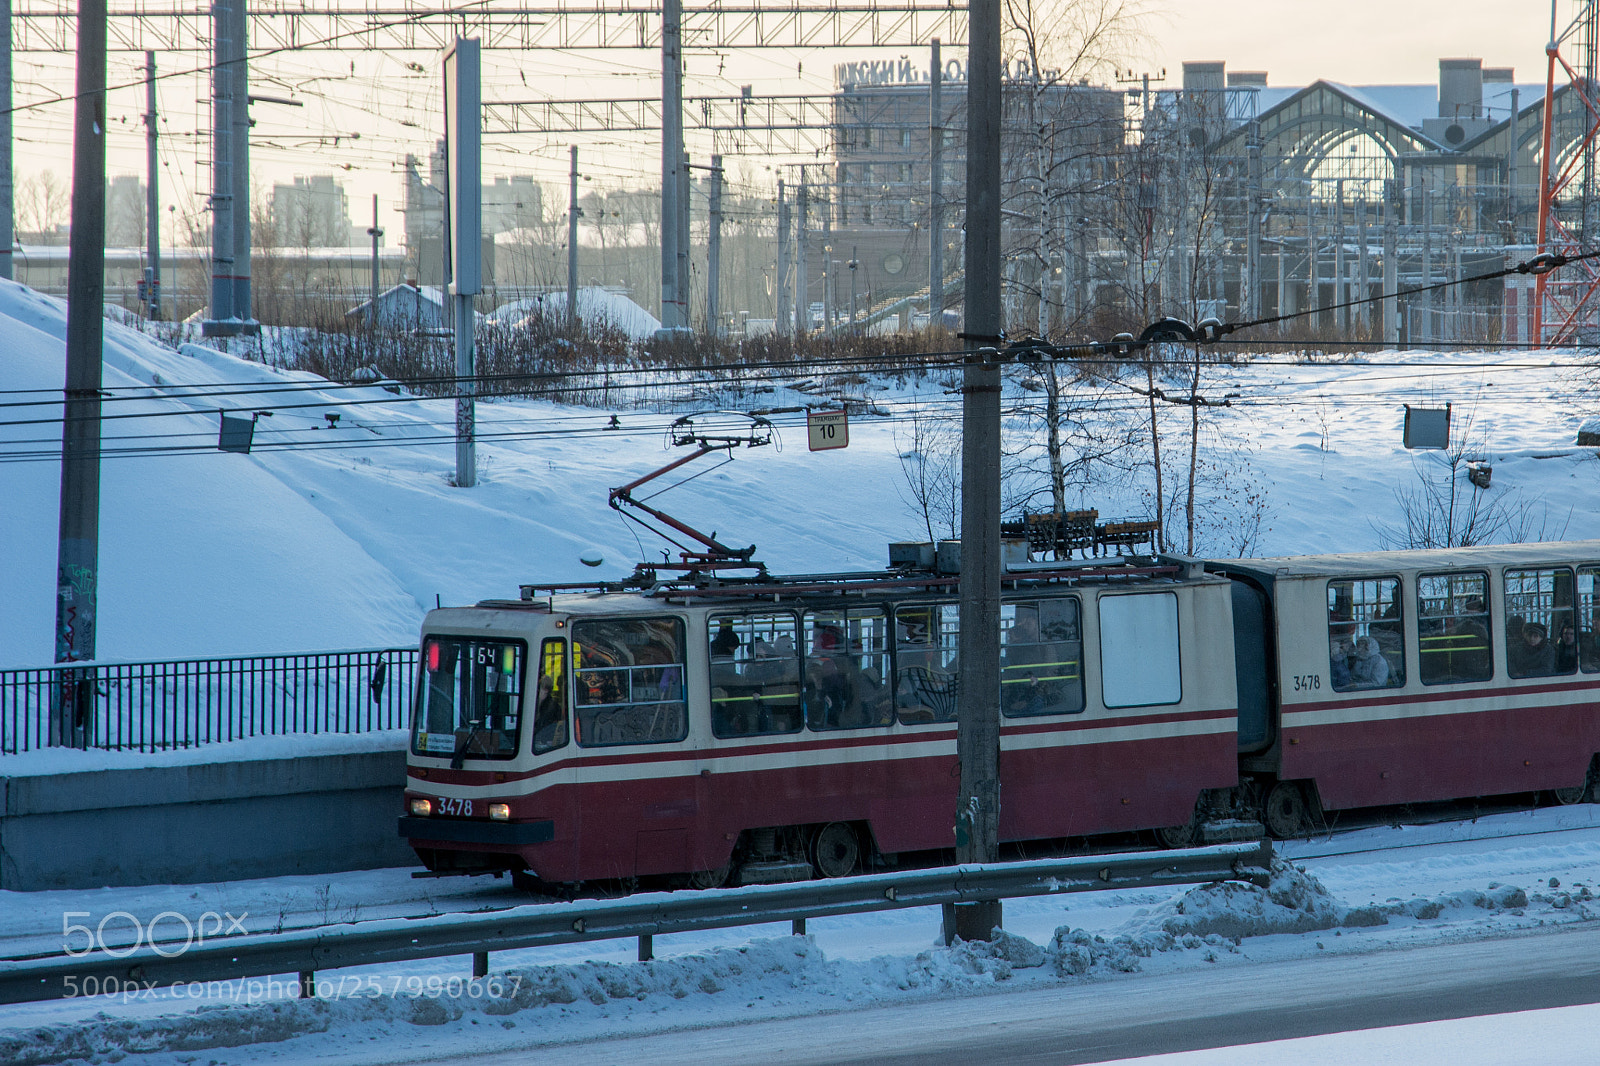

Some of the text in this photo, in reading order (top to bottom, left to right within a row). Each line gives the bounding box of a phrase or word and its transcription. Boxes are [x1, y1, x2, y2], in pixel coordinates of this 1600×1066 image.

[820, 424, 835, 439] 10
[478, 647, 495, 664] 64
[1293, 674, 1321, 692] 3478
[438, 797, 473, 817] 3478
